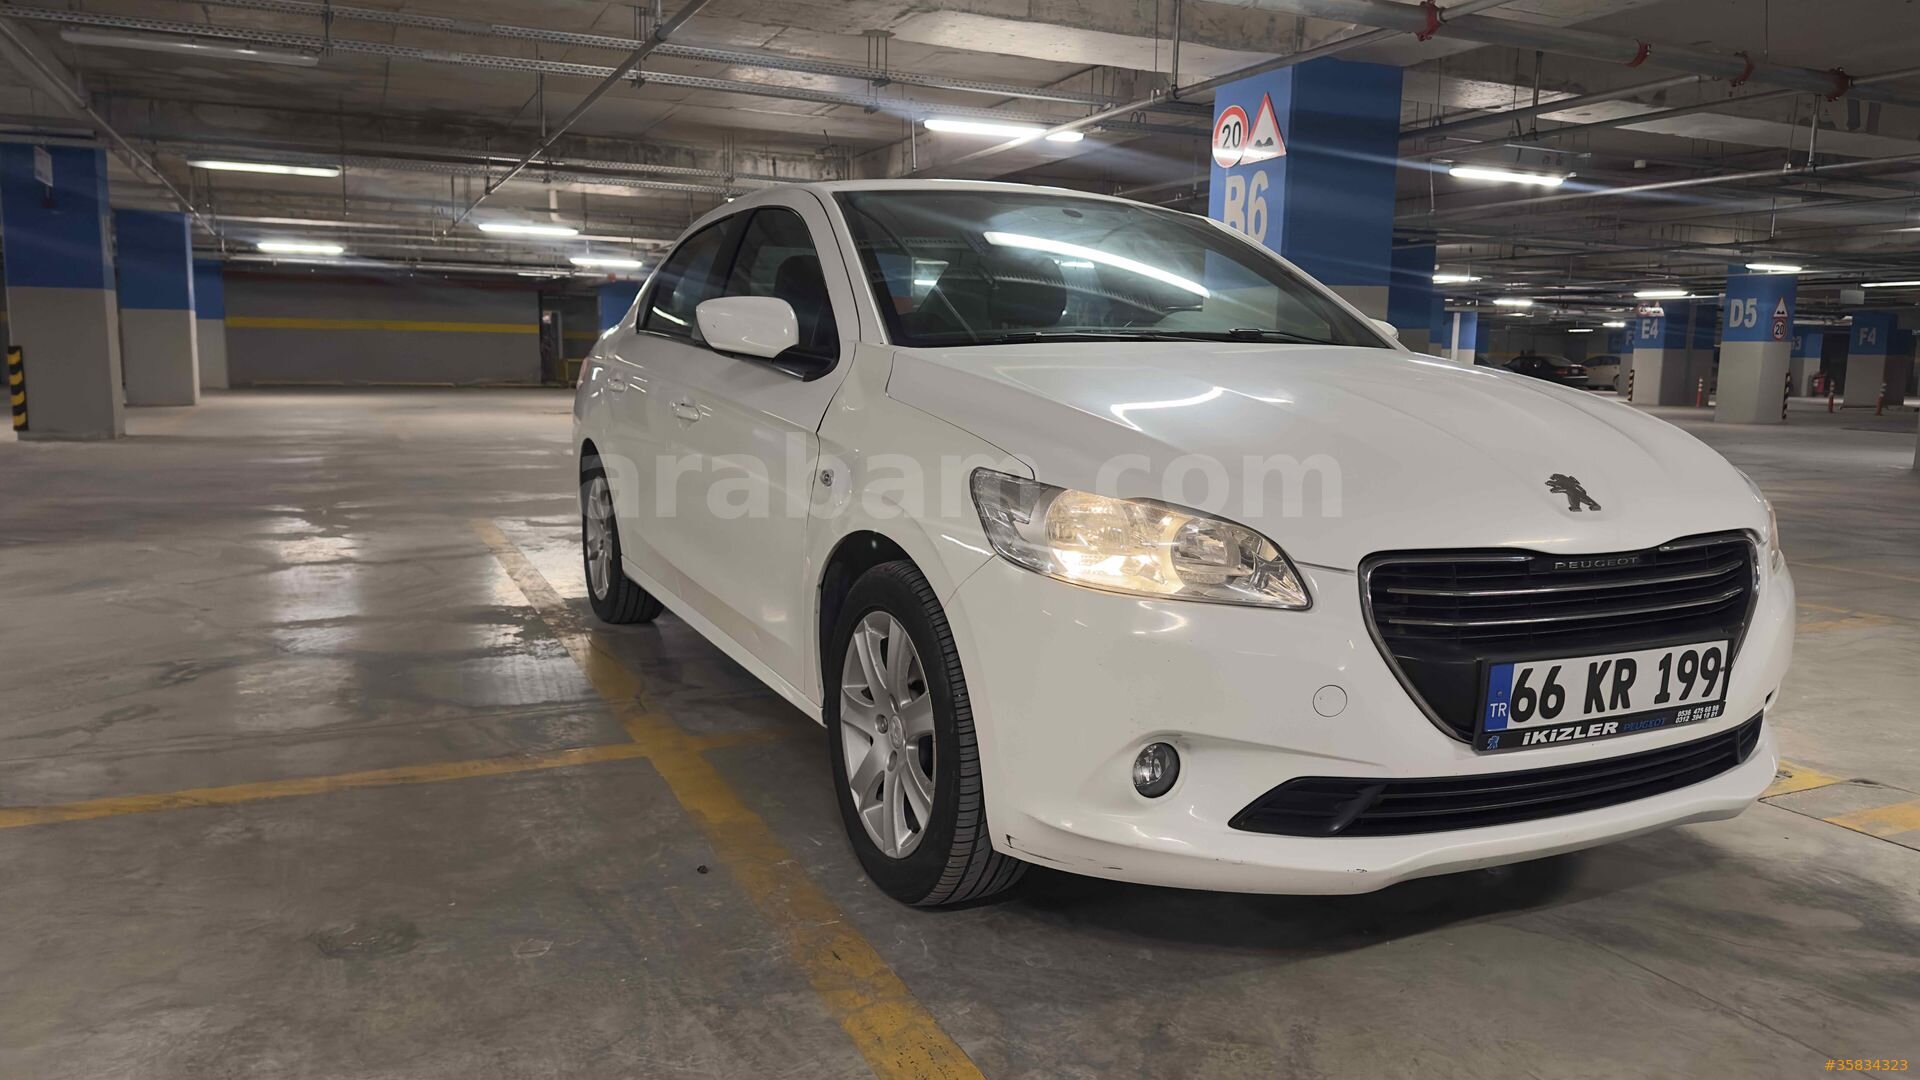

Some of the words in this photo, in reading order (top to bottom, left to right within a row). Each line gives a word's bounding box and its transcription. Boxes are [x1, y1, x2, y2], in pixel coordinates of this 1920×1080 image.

[1222, 120, 1241, 149] 20
[1223, 170, 1269, 245] B6
[1729, 298, 1757, 328] D5
[1641, 319, 1659, 339] E4
[1775, 324, 1785, 336] 20
[1859, 327, 1876, 346] F4
[1554, 557, 1638, 569] PEUGEOT
[1510, 665, 1565, 723] 66
[1583, 658, 1637, 715] KR
[1653, 646, 1722, 705] 199
[1490, 702, 1508, 719] TR
